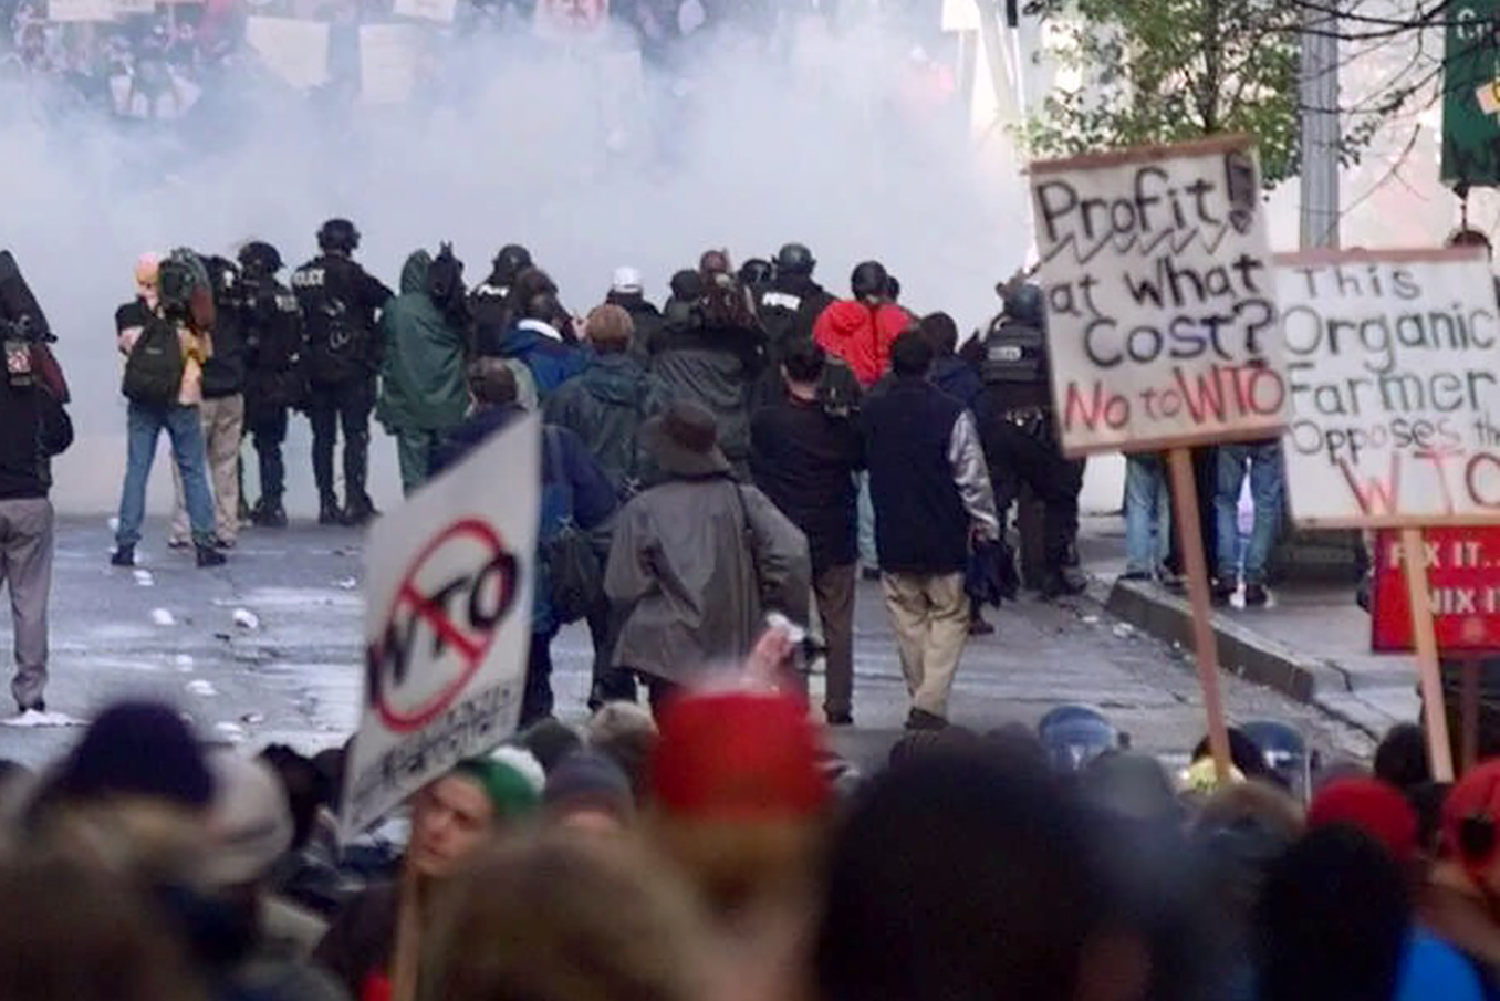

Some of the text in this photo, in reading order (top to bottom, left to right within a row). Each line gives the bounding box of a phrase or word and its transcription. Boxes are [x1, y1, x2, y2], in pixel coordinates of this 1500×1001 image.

[1050, 273, 1105, 318] at
[1300, 265, 1421, 300] This
[1283, 303, 1495, 375] Organic
[1064, 379, 1130, 431] No
[1173, 364, 1285, 424] WTO
[1389, 541, 1441, 568] FX
[367, 551, 520, 710] WTO
